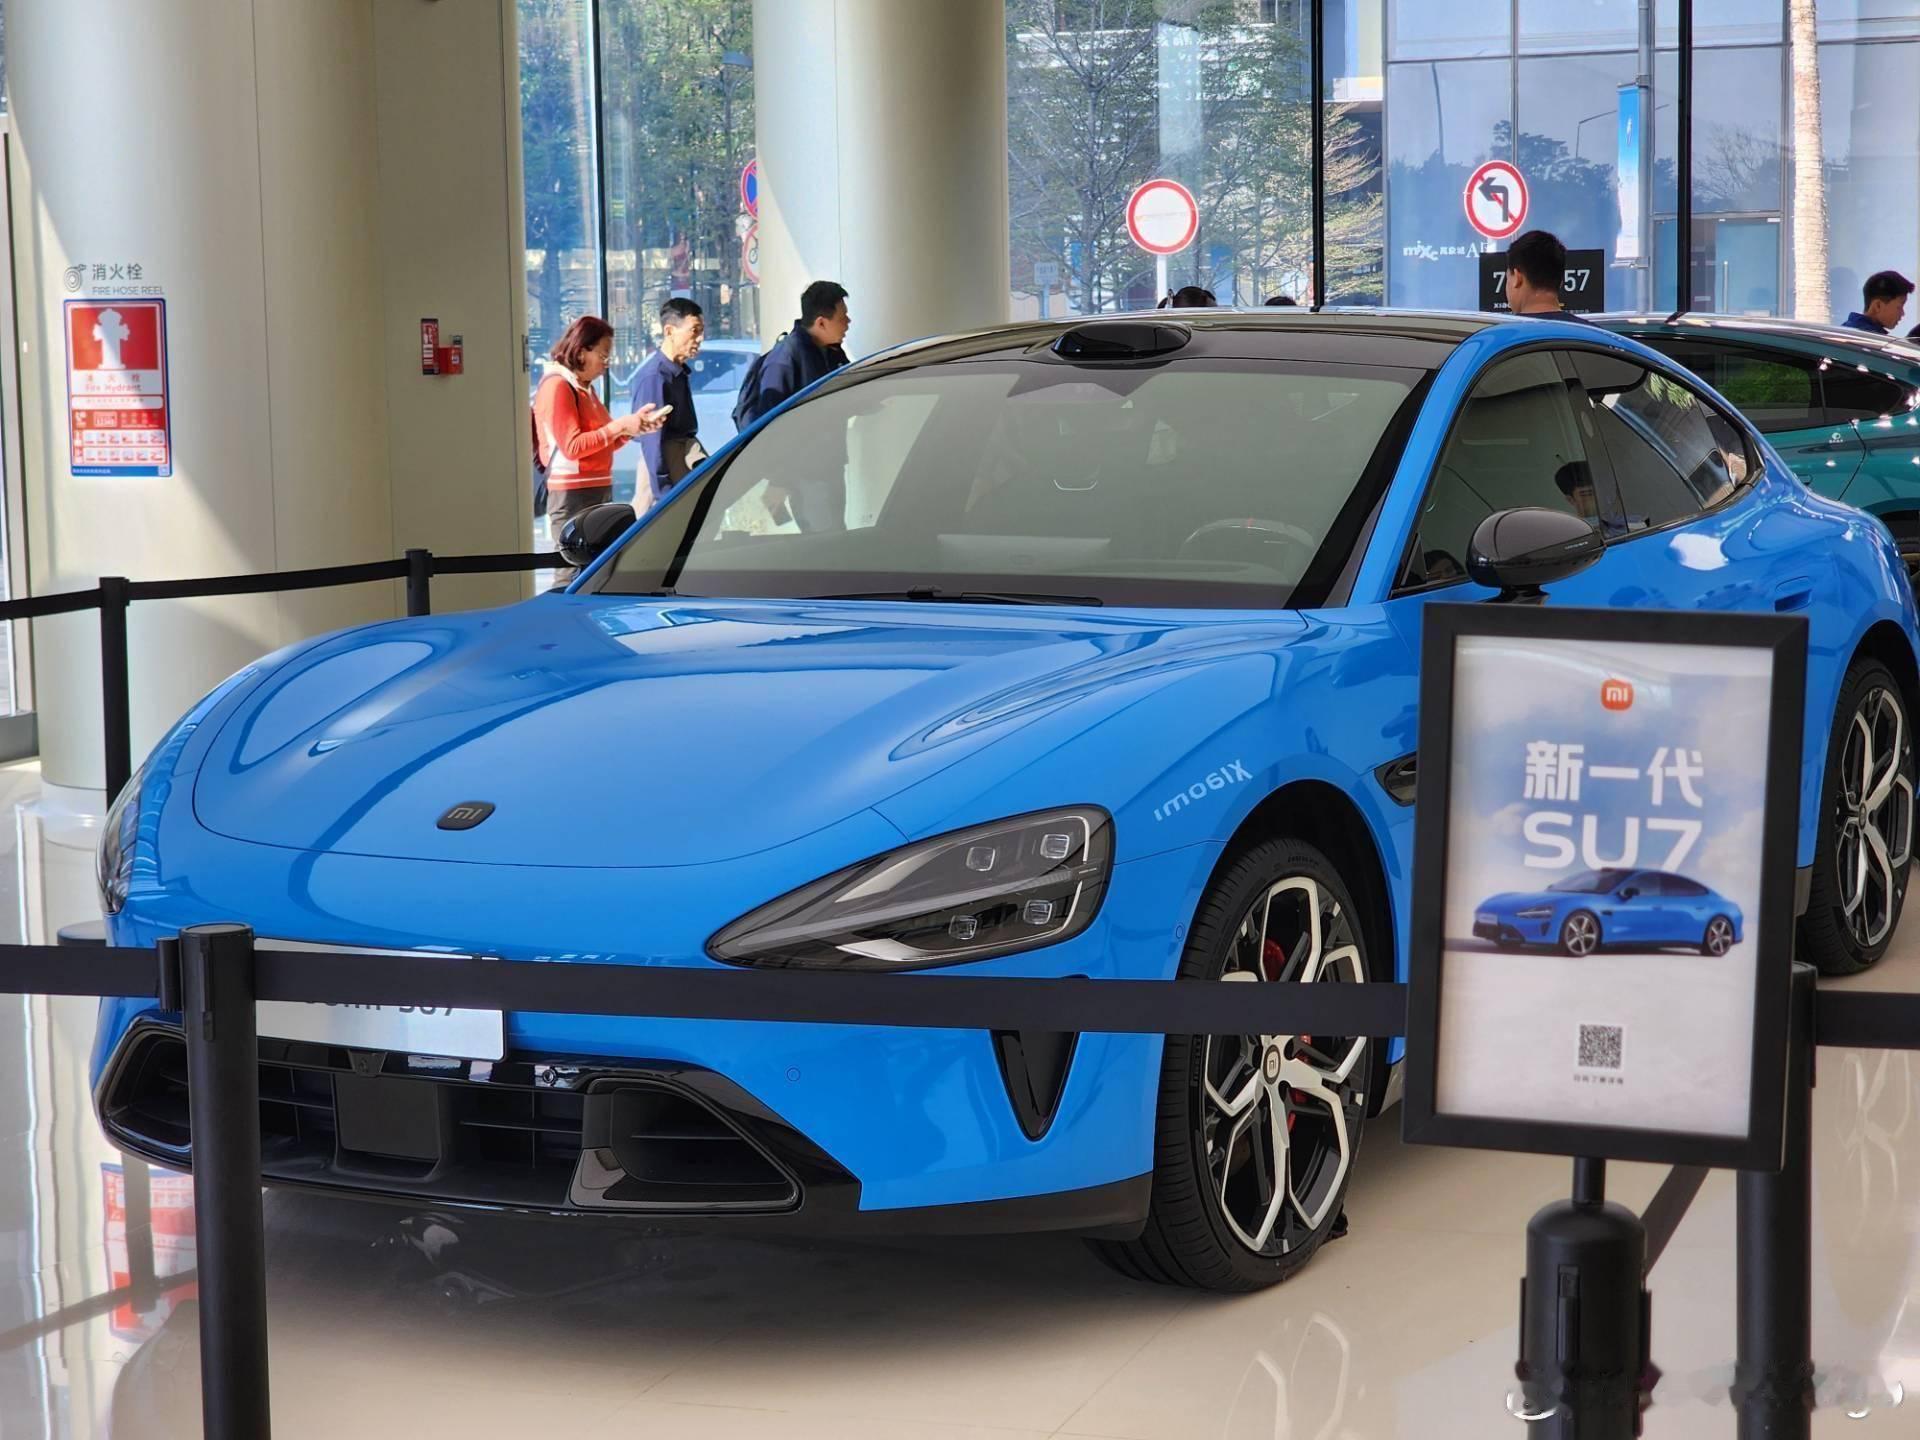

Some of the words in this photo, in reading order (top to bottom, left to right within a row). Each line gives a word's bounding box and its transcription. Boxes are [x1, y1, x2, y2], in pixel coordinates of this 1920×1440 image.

[92, 263, 143, 280] 消火栓
[92, 286, 110, 295] FIRE
[112, 286, 139, 295] HOSE
[141, 286, 164, 295] REEL
[1523, 740, 1704, 808] 新一代
[1523, 811, 1703, 872] SU7
